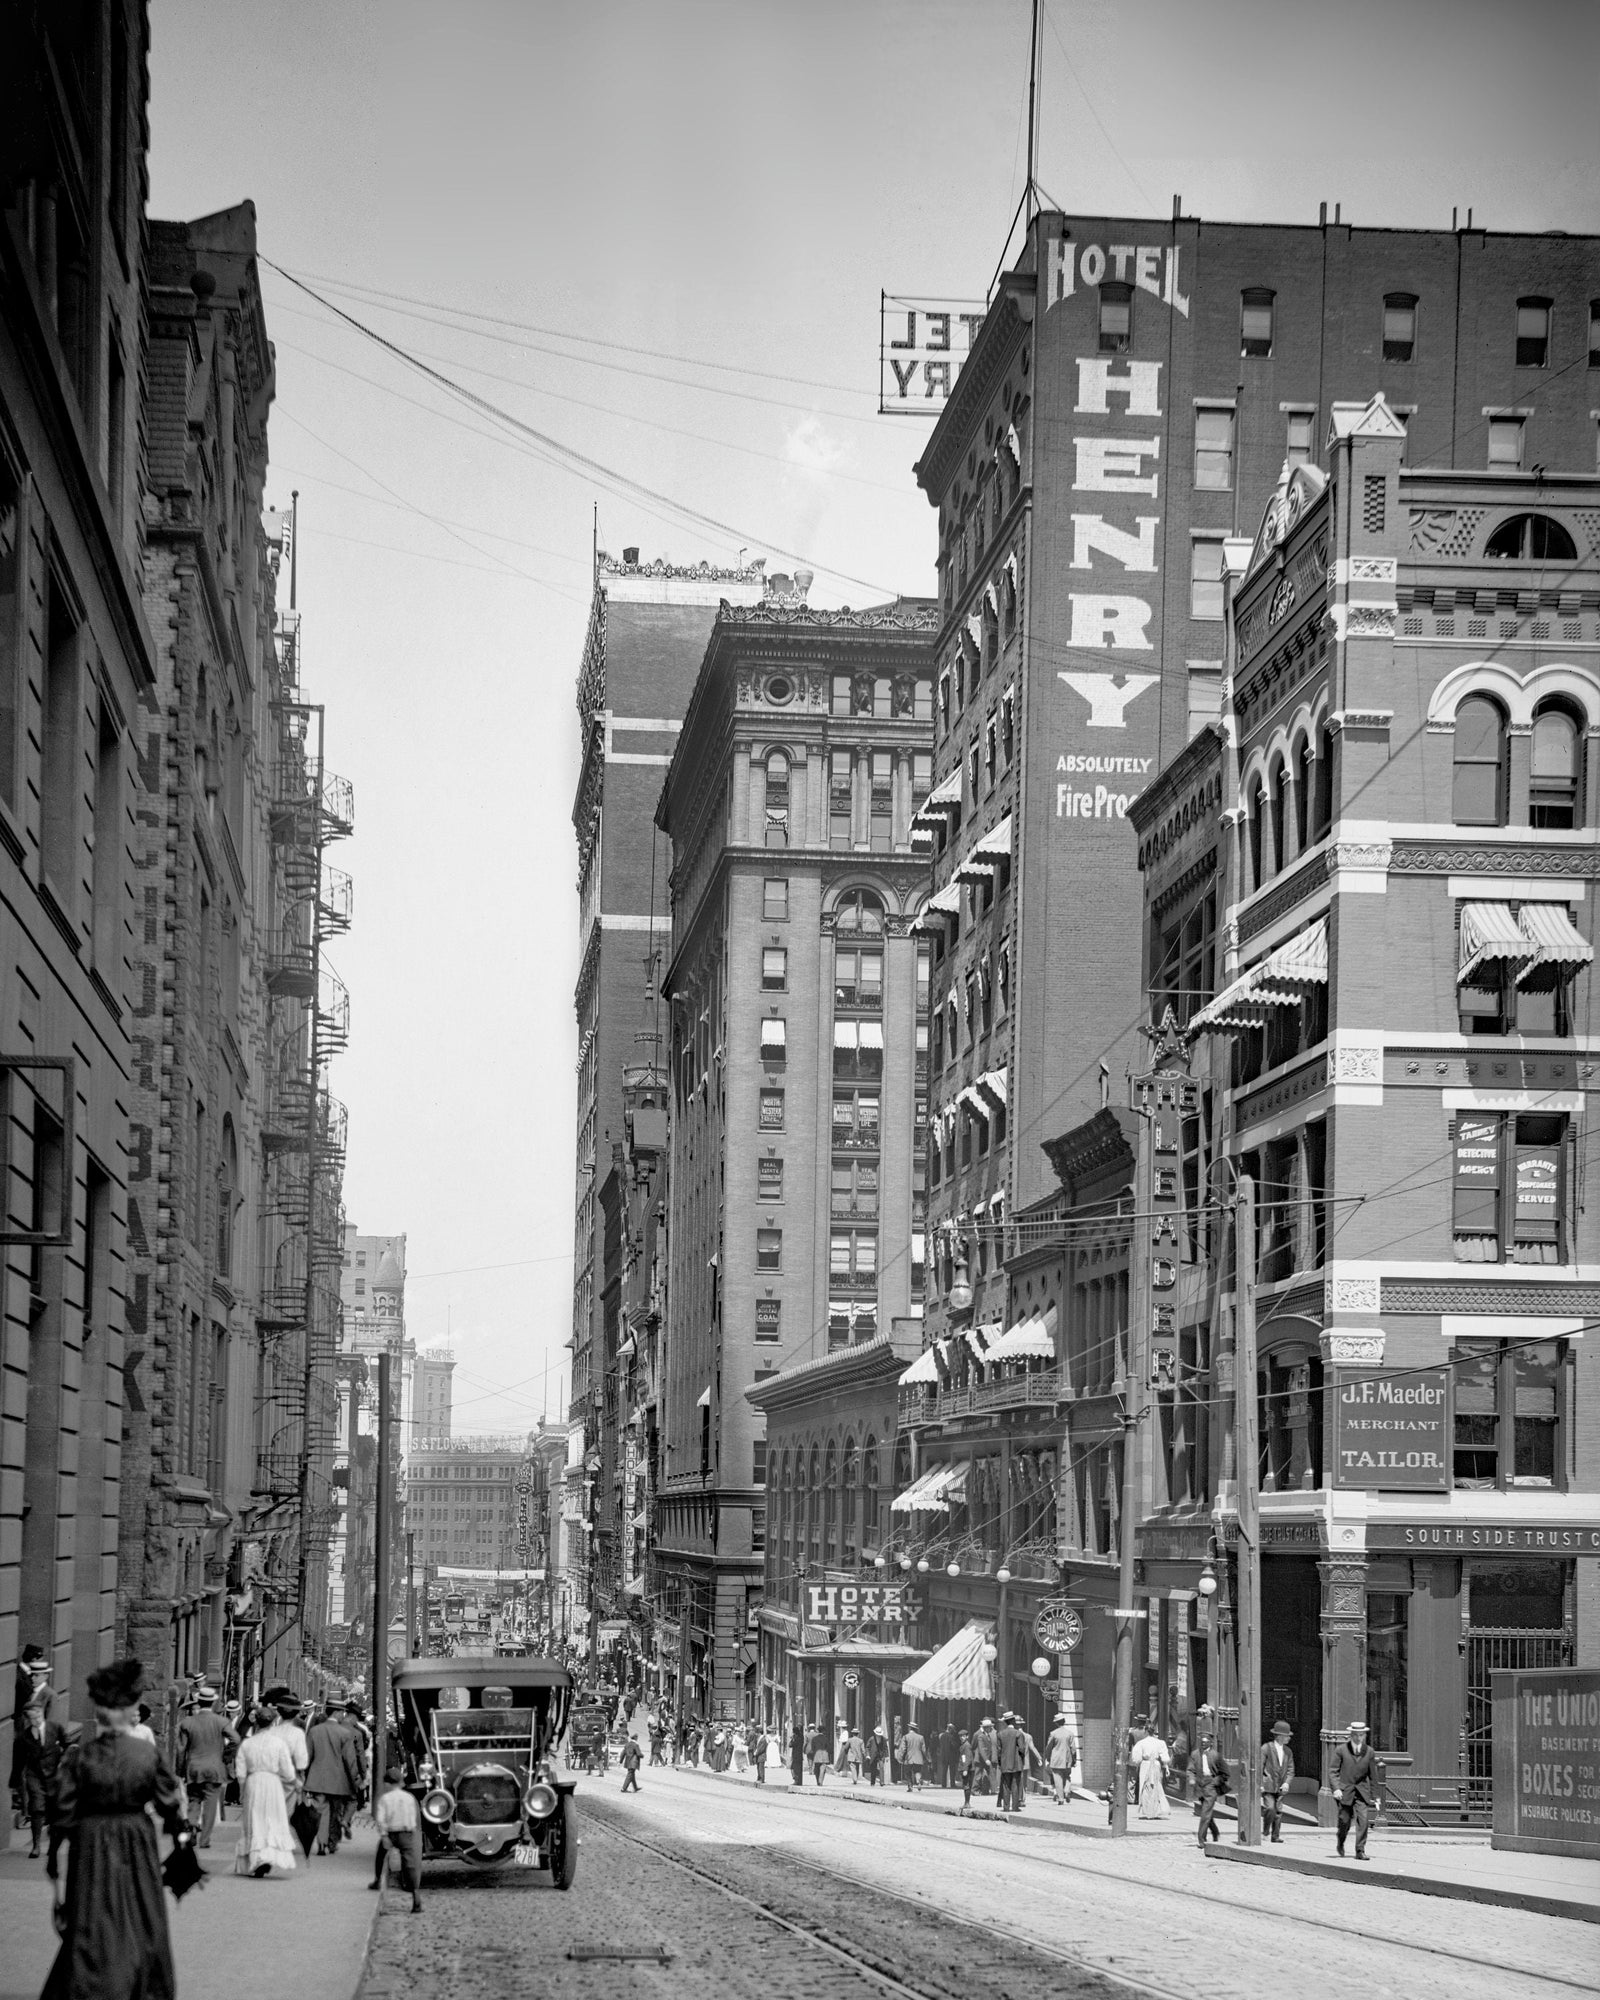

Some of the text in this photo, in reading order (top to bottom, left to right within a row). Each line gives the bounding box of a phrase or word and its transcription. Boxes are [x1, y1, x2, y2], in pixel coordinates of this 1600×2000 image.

[1046, 238, 1190, 319] HOTEL
[1057, 358, 1163, 728] HENRY
[1056, 755, 1152, 773] ABSOLUTELY
[1136, 1081, 1198, 1110] THE
[1457, 1148, 1497, 1158] DETECTIVE
[1459, 1165, 1496, 1174] AGENCY
[1518, 1195, 1556, 1204] SERVED
[1152, 1120, 1178, 1382] LEADER
[1346, 1419, 1440, 1431] MERCHANT
[1342, 1451, 1445, 1468] TAILOR.
[625, 1446, 636, 1507] HOTEL
[1405, 1529, 1464, 1544] SOUTH
[1472, 1530, 1515, 1545] SIDE
[1525, 1531, 1583, 1546] TRUST
[624, 1511, 635, 1584] NEWELL
[809, 1587, 923, 1620] HOTEL
[1039, 1608, 1079, 1633] BALTIMORE
[1043, 1636, 1075, 1651] LUNCH
[1522, 1688, 1600, 1727] THE UNIO
[1541, 1737, 1589, 1751] BASEMENT
[1522, 1763, 1574, 1797] BOXES
[1578, 1766, 1594, 1779] FOR
[1521, 1804, 1558, 1820] INSURANCE
[1560, 1807, 1592, 1824] POLICIES
[516, 1848, 537, 1864] 2781
